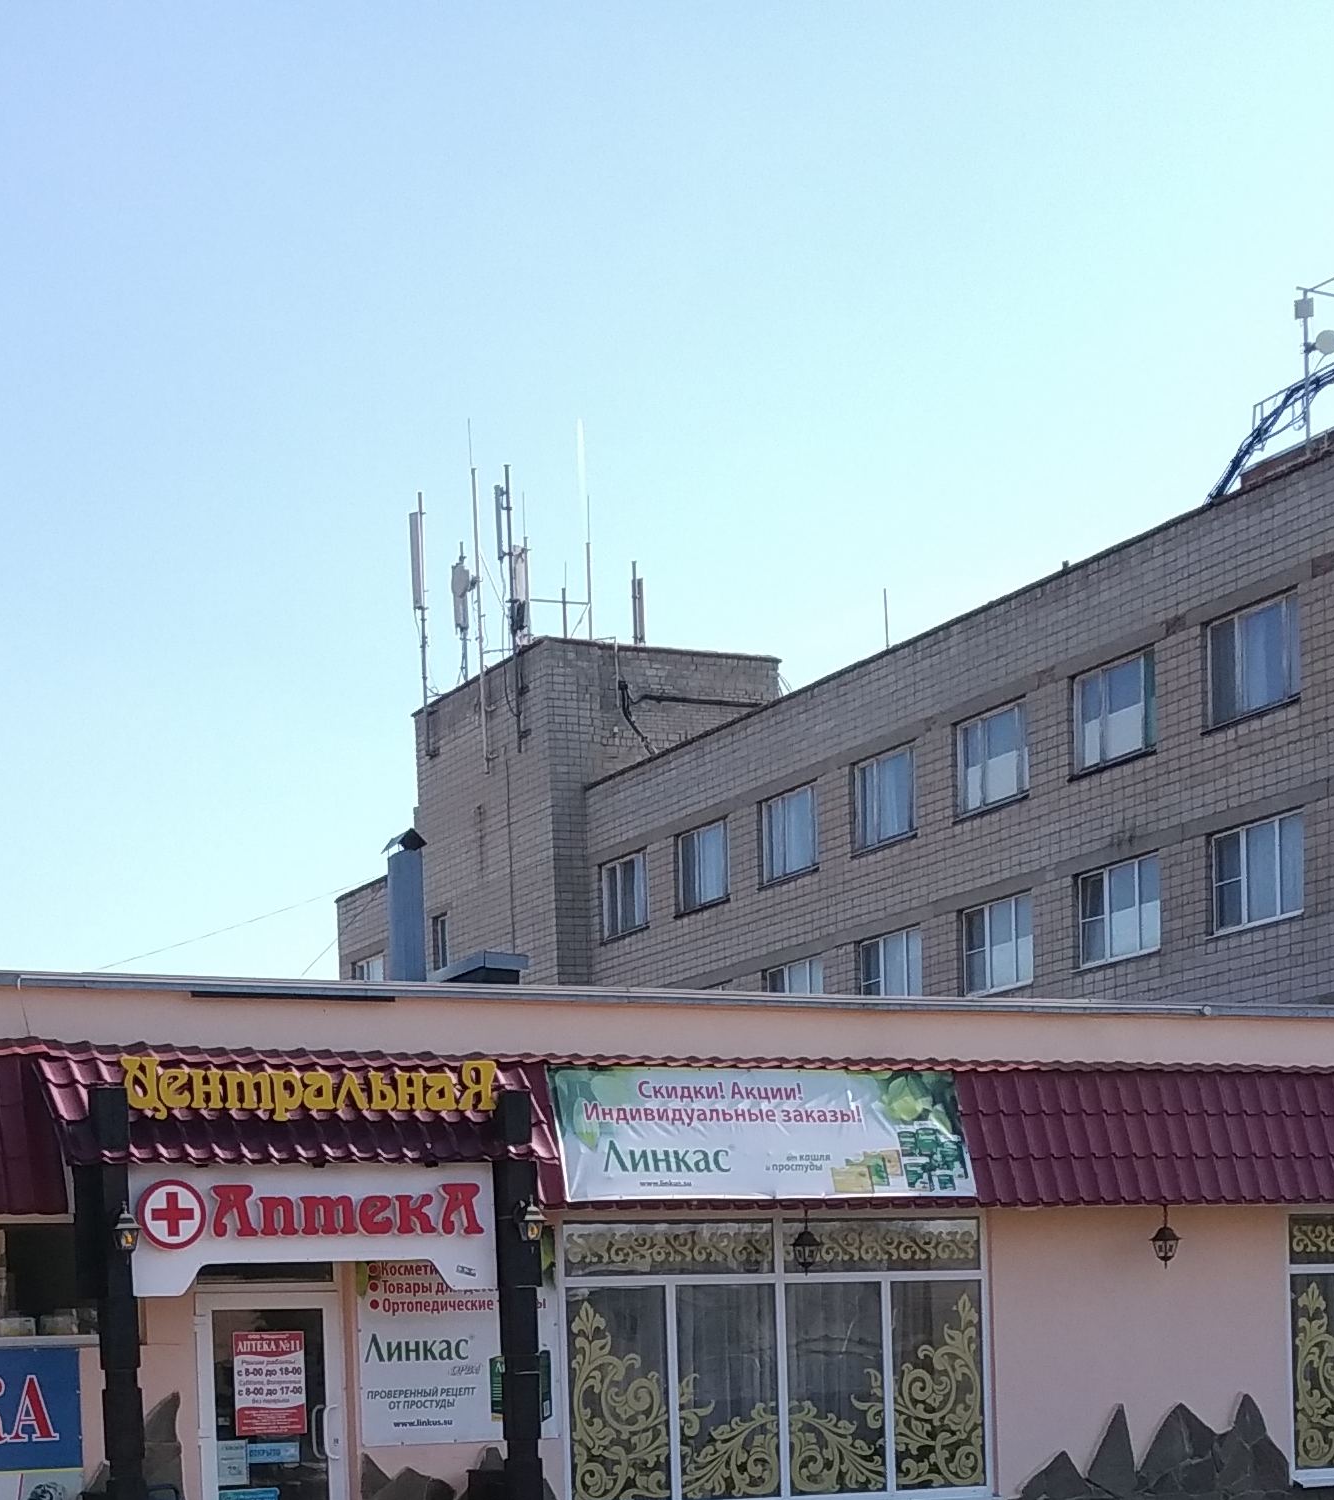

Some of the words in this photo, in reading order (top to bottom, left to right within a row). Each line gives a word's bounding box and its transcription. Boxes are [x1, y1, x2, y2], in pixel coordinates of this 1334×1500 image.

[638, 1080, 725, 1103] Скидки!
[730, 1081, 803, 1104] Акции!
[583, 1102, 776, 1127] Индивидуальные
[780, 1105, 863, 1123] заказы!
[604, 1139, 732, 1173] Линкас
[799, 1153, 831, 1161] кашля
[772, 1161, 823, 1173] простуды
[382, 1280, 432, 1297] Товары
[382, 1298, 494, 1316] Ортопедические
[237, 1340, 276, 1352] АПТЕКА
[278, 1340, 300, 1352] №11
[365, 1333, 469, 1363] Линкас
[244, 1367, 264, 1377] 8-00
[265, 1369, 277, 1377] до
[279, 1366, 302, 1376] 18-00
[245, 1386, 264, 1396] 8-00
[265, 1388, 278, 1397] до
[280, 1386, 303, 1395] 17-00
[367, 1386, 438, 1400] ПРОВЕРЕННЫЙ
[440, 1386, 476, 1398] РЕЦЕПТ
[388, 1401, 401, 1410] ОТ
[403, 1399, 456, 1409] ПРОСТУДЫ
[393, 1419, 453, 1427] www.linkus.su
[248, 1448, 281, 1458] ОТКРЫТО
